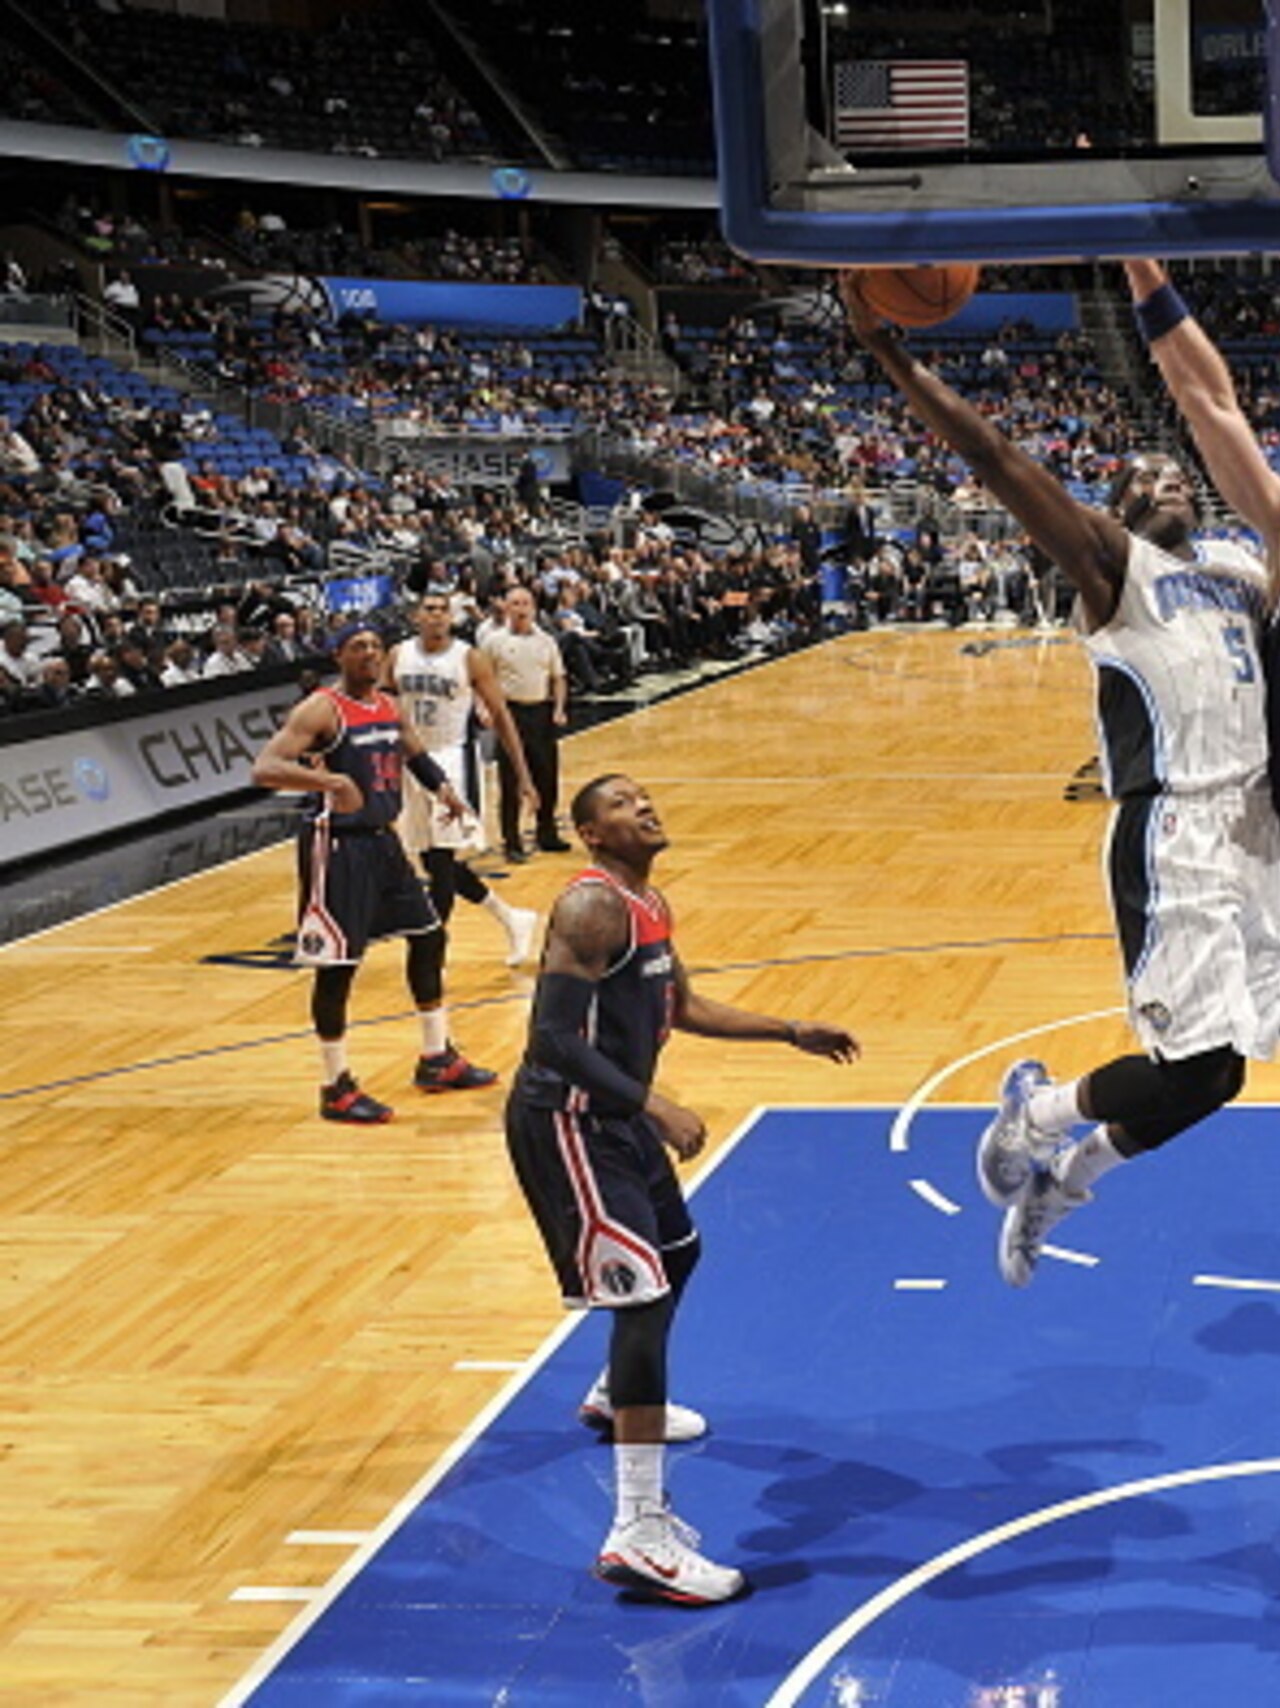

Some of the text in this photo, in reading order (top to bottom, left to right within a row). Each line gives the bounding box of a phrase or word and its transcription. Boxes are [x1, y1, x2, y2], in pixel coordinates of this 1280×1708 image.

[1223, 624, 1255, 684] 5
[413, 699, 438, 727] 12
[0, 769, 78, 822] ASE
